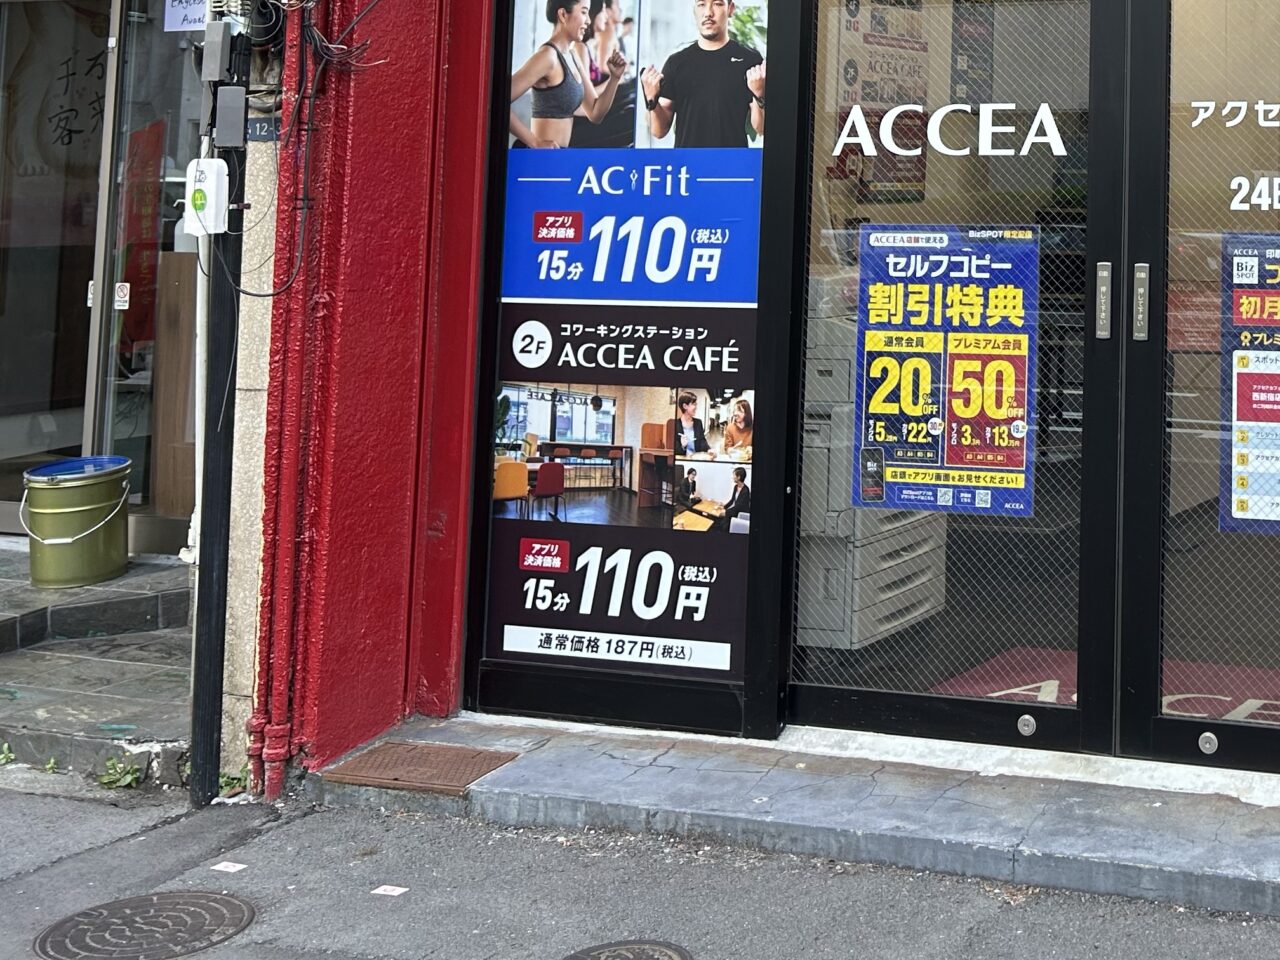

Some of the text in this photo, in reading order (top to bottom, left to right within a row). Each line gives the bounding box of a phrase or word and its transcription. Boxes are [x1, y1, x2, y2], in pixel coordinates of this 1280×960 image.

[831, 102, 1068, 157] ACCEA
[577, 165, 690, 196] AC Fit
[545, 216, 572, 227] アプリ
[538, 227, 575, 239] 決済価格
[690, 228, 729, 244] (税込)
[537, 215, 722, 284] 15分 110円
[886, 254, 1012, 279] セルフコピー
[1236, 262, 1255, 272] Biz
[867, 282, 1025, 327] 割引特典
[560, 323, 709, 341] コワーキングステーション
[883, 336, 925, 348] 通常会員
[519, 335, 546, 355] 2F
[953, 338, 1022, 350] プレミアム会員
[557, 340, 739, 373] ACCEA CAFÉ
[868, 356, 932, 416] 20
[951, 359, 1016, 420] 50
[531, 543, 558, 556] アプリ
[524, 554, 561, 569] 決済価格
[523, 546, 710, 622] 15分 110円
[678, 565, 718, 583] (税込)
[538, 632, 693, 661] 通常価格 187円(税込)
